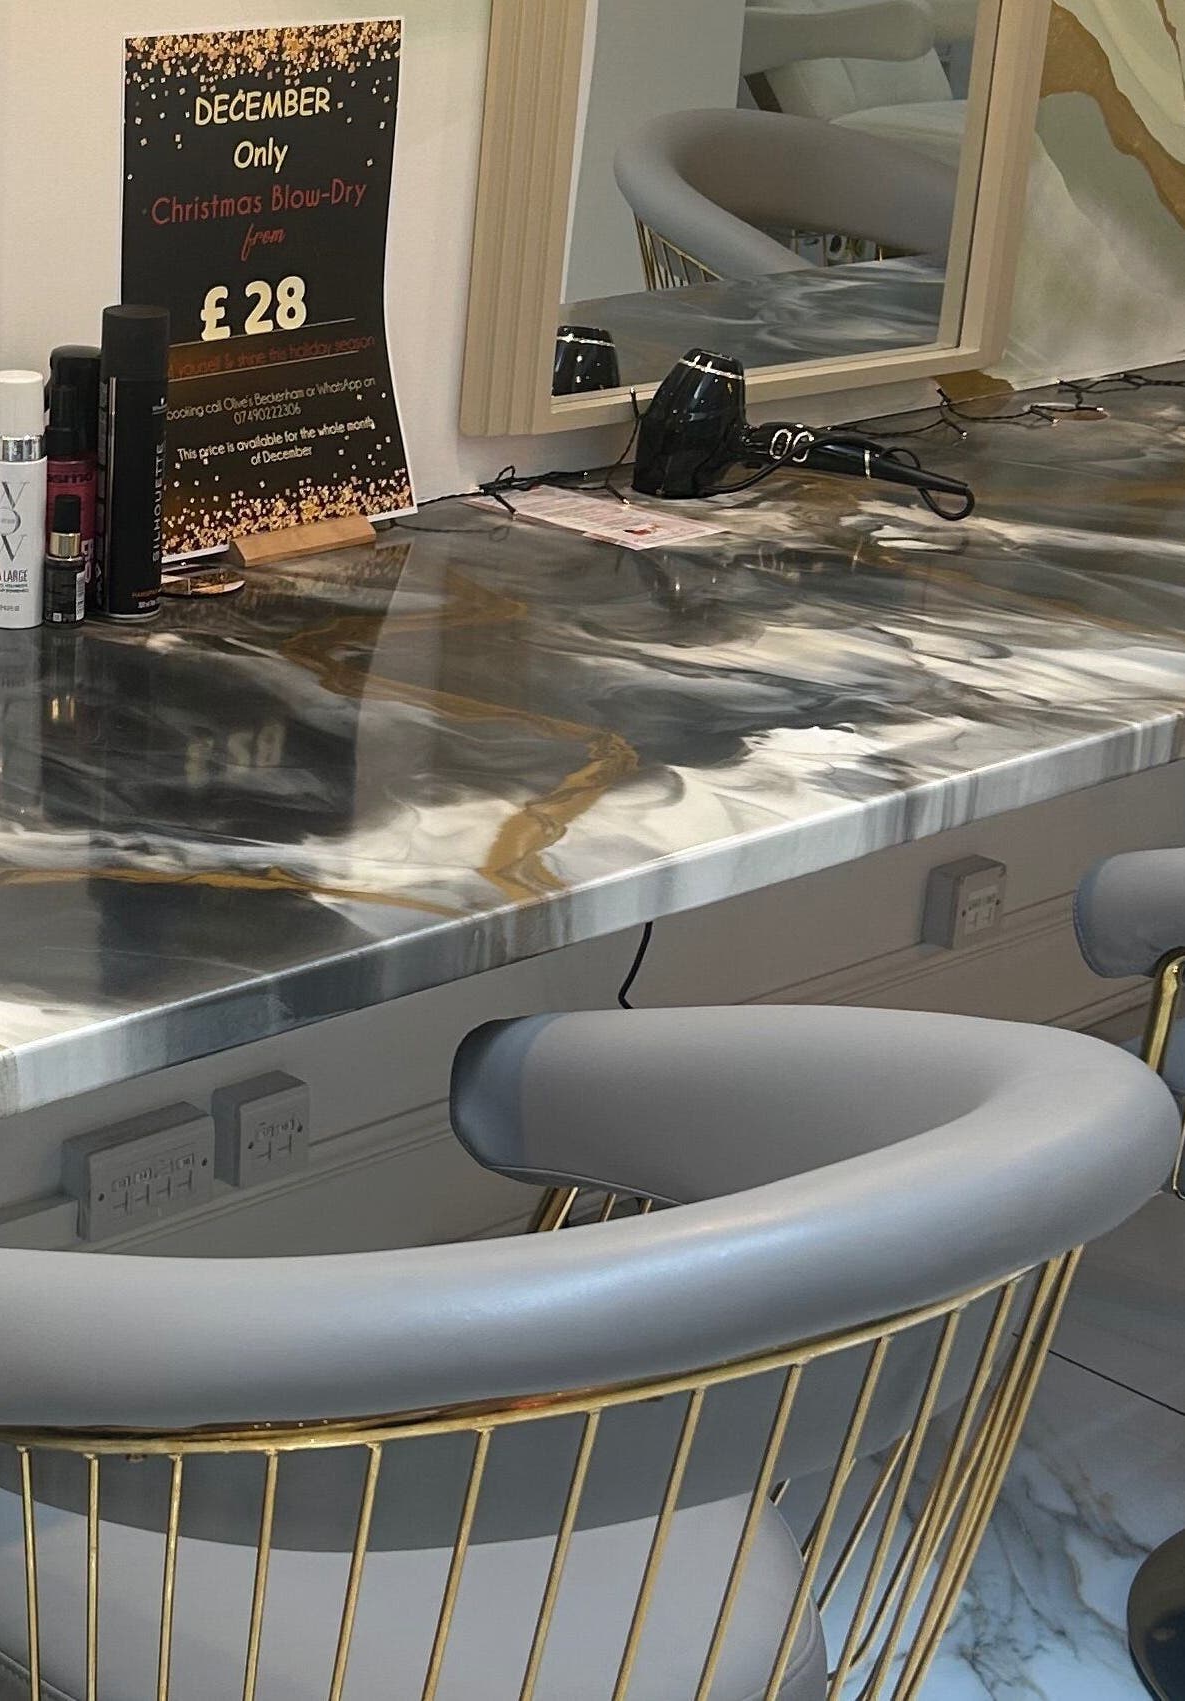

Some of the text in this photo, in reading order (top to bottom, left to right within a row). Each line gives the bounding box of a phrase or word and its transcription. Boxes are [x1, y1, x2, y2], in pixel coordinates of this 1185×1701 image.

[194, 87, 331, 126] DECEMBER
[233, 137, 289, 173] Only
[151, 178, 367, 225] Christmas Blow-Dry
[241, 223, 287, 262] from
[200, 276, 307, 341] £ 28
[335, 335, 376, 351] season
[206, 401, 223, 415] call
[224, 396, 253, 412] Olive's
[306, 387, 316, 398] or
[317, 378, 362, 395] WhatsApp
[363, 377, 376, 388] on
[234, 405, 302, 425] 07490222306
[177, 447, 197, 462] This
[198, 444, 226, 460] price
[226, 441, 235, 453] is
[236, 431, 283, 451] available
[284, 428, 298, 442] for
[300, 425, 316, 440] the
[317, 421, 345, 436] whole
[251, 445, 312, 466] of December
[152, 444, 165, 562] SILHOUETTE
[3, 569, 28, 583] LARGE
